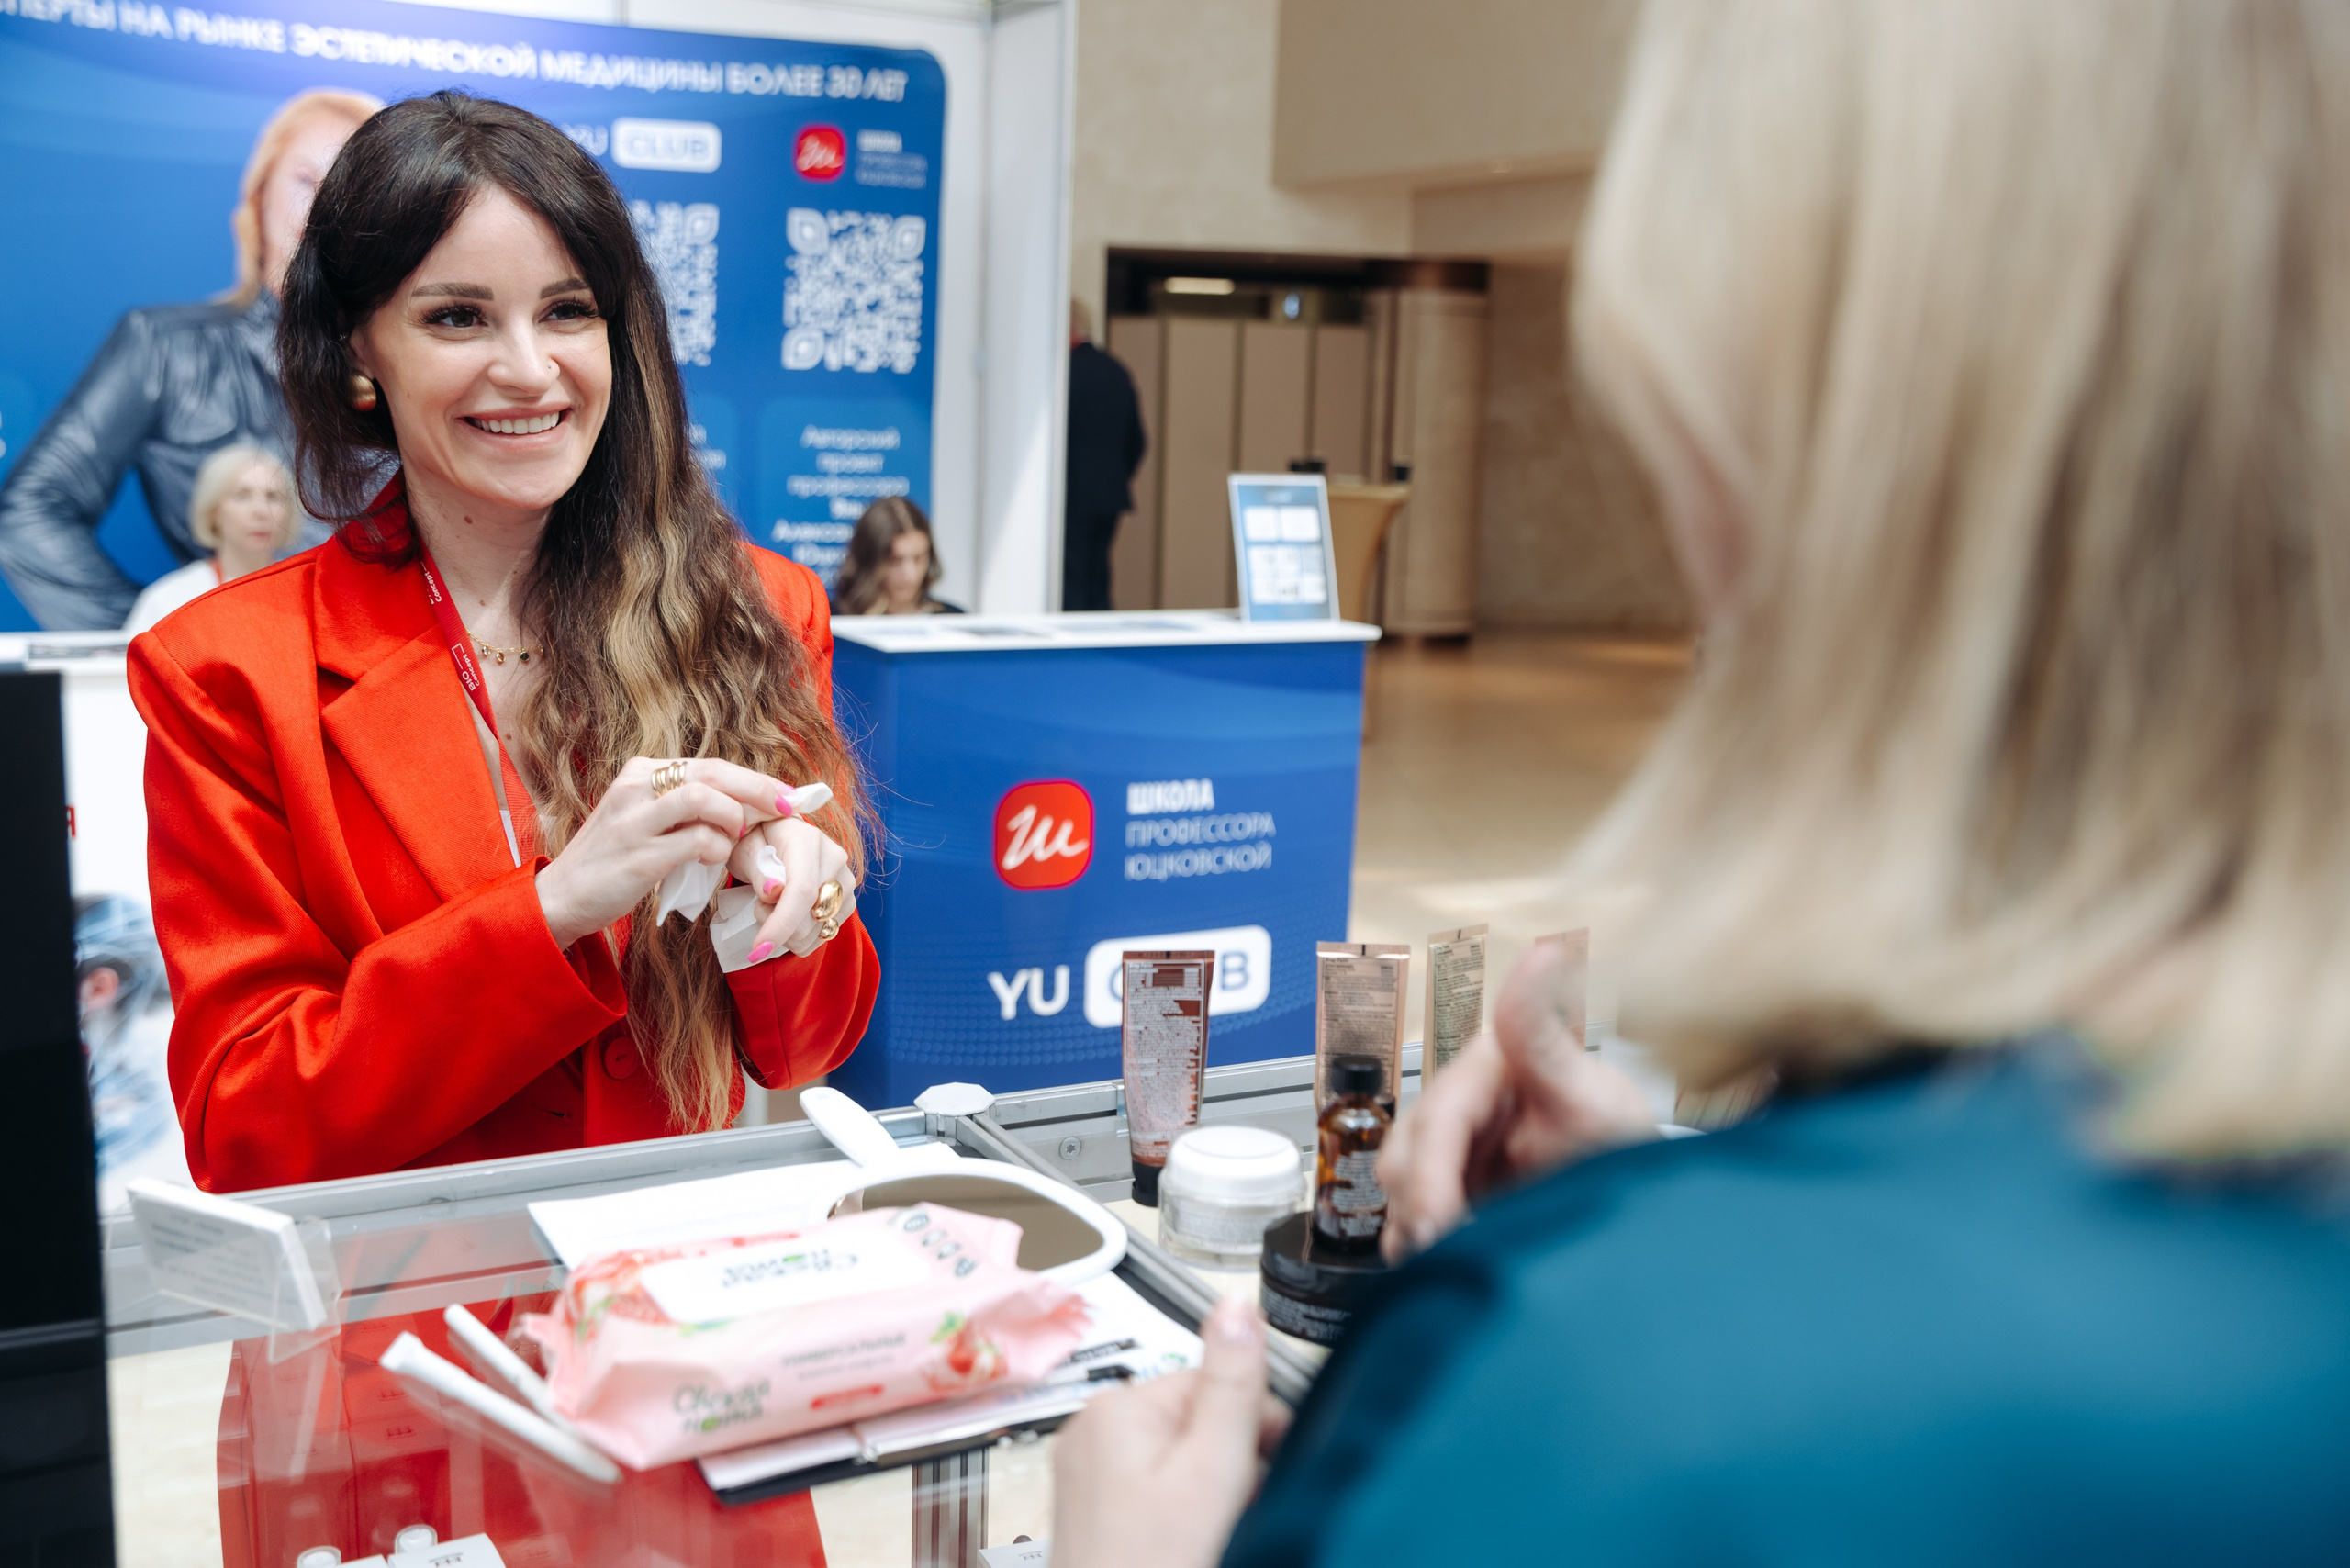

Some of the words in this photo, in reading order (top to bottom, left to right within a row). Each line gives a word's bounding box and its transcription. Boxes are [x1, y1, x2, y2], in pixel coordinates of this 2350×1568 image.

[118, 1, 173, 39] НА
[174, 7, 286, 53] РЫНКЕ
[289, 22, 538, 80] ЭСТЕТИЧЕСКОЙ
[540, 49, 723, 92] МЕДИЦИНЫ
[725, 62, 824, 96] БОЛЕЕ
[826, 65, 863, 98] 30
[862, 68, 908, 102] ЛЕТ
[424, 570, 442, 602] Concept
[462, 670, 476, 691] BIO
[463, 654, 480, 687] Concept
[1127, 778, 1214, 814] ШКОЛА
[1125, 812, 1276, 847] ПРОФЕССОРА
[1125, 841, 1272, 882] ЮЦКОВСКОЙ
[987, 965, 1070, 1020] YU
